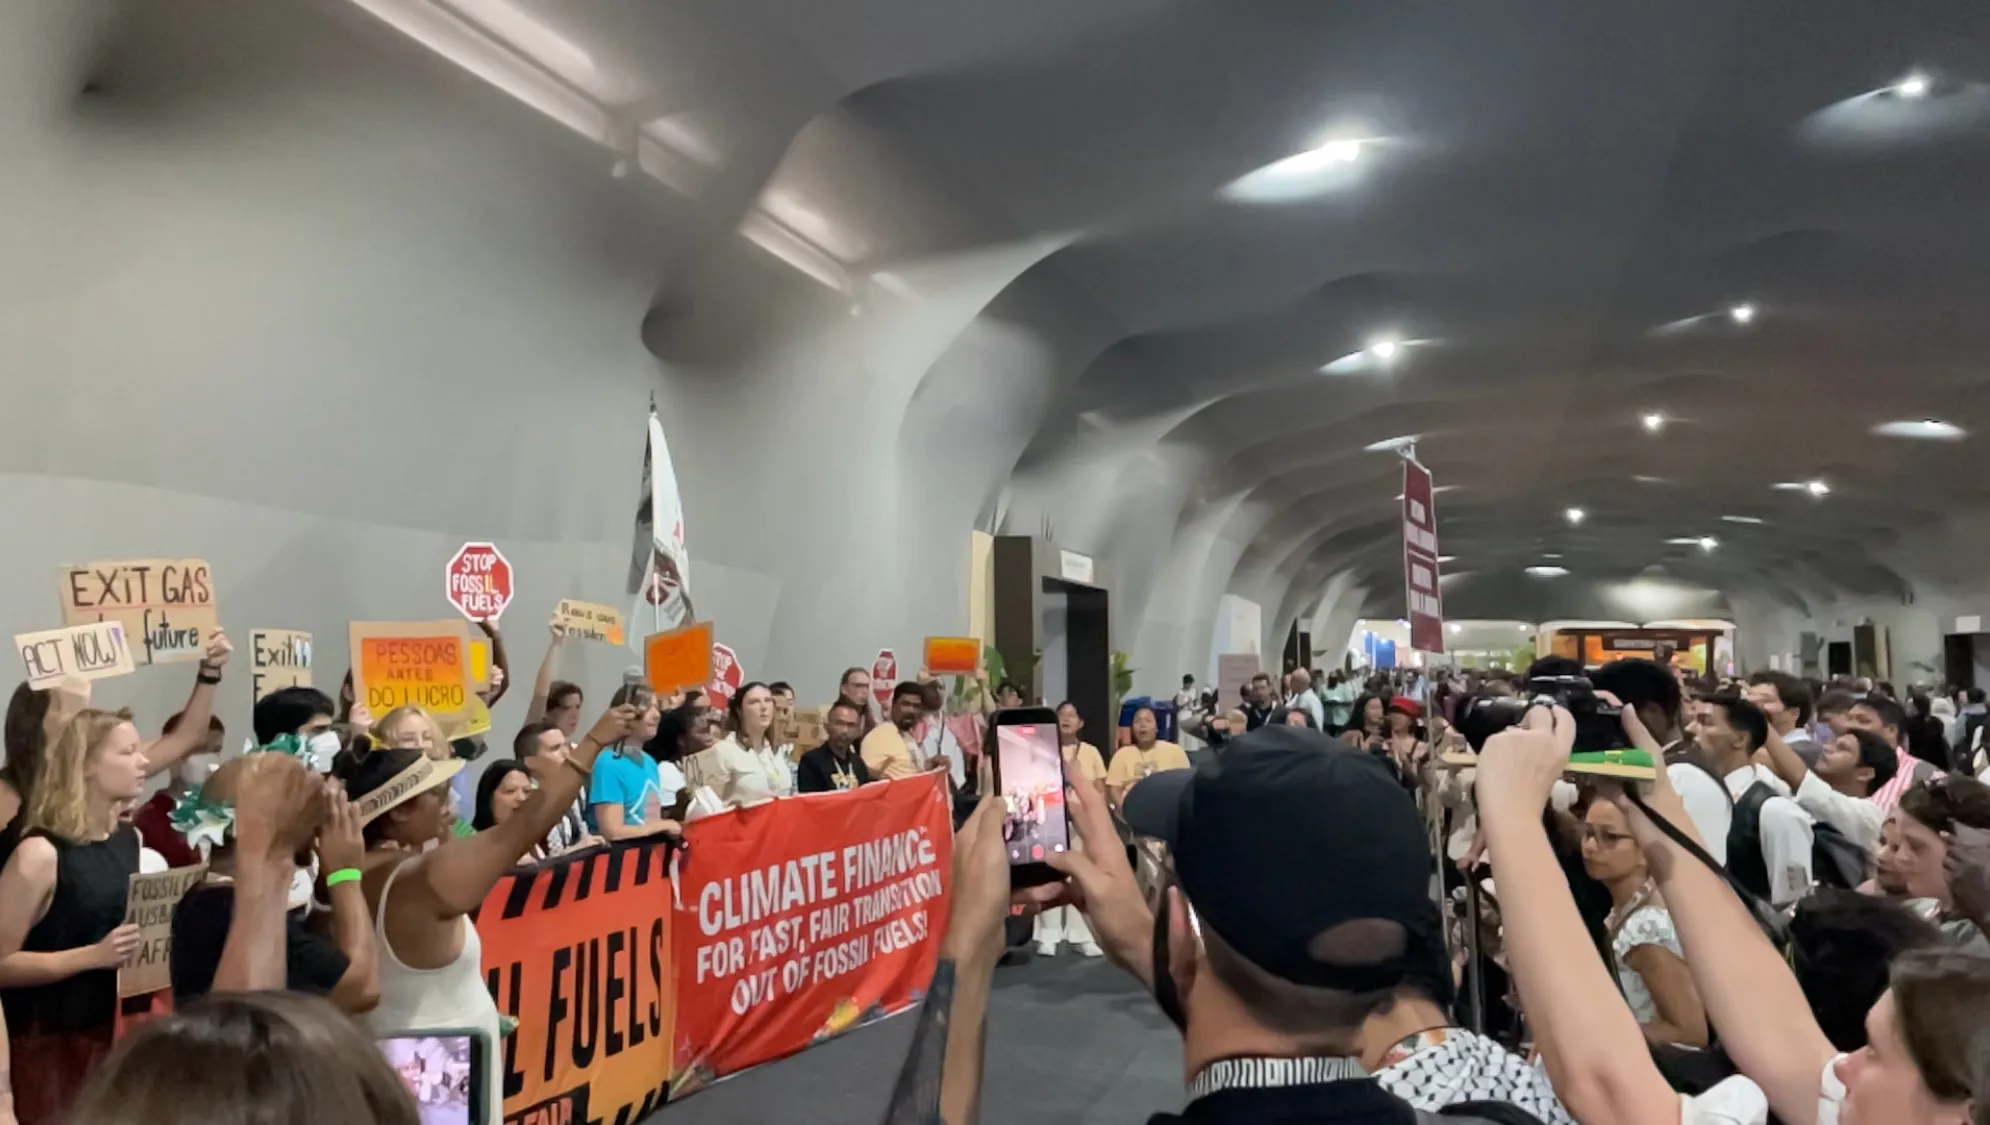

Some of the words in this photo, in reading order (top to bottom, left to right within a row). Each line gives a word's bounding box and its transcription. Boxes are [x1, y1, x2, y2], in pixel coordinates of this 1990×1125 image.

[461, 553, 497, 574] STOP
[162, 565, 209, 604] GAS
[452, 572, 499, 595] FOSSIL
[461, 593, 504, 613] FUELS
[143, 608, 199, 664] future
[376, 642, 458, 666] PESSOAS
[22, 638, 64, 678] ACT
[368, 686, 395, 708] DO
[699, 851, 838, 936] CLIMATE
[843, 826, 937, 893] FINANCE
[697, 936, 745, 985] FOR
[749, 915, 806, 965] FAST,
[809, 902, 850, 943] FAIR
[731, 966, 778, 1016] OUT
[782, 955, 811, 994] OF
[872, 910, 928, 960] FUELS!
[543, 916, 663, 1083] FUELS
